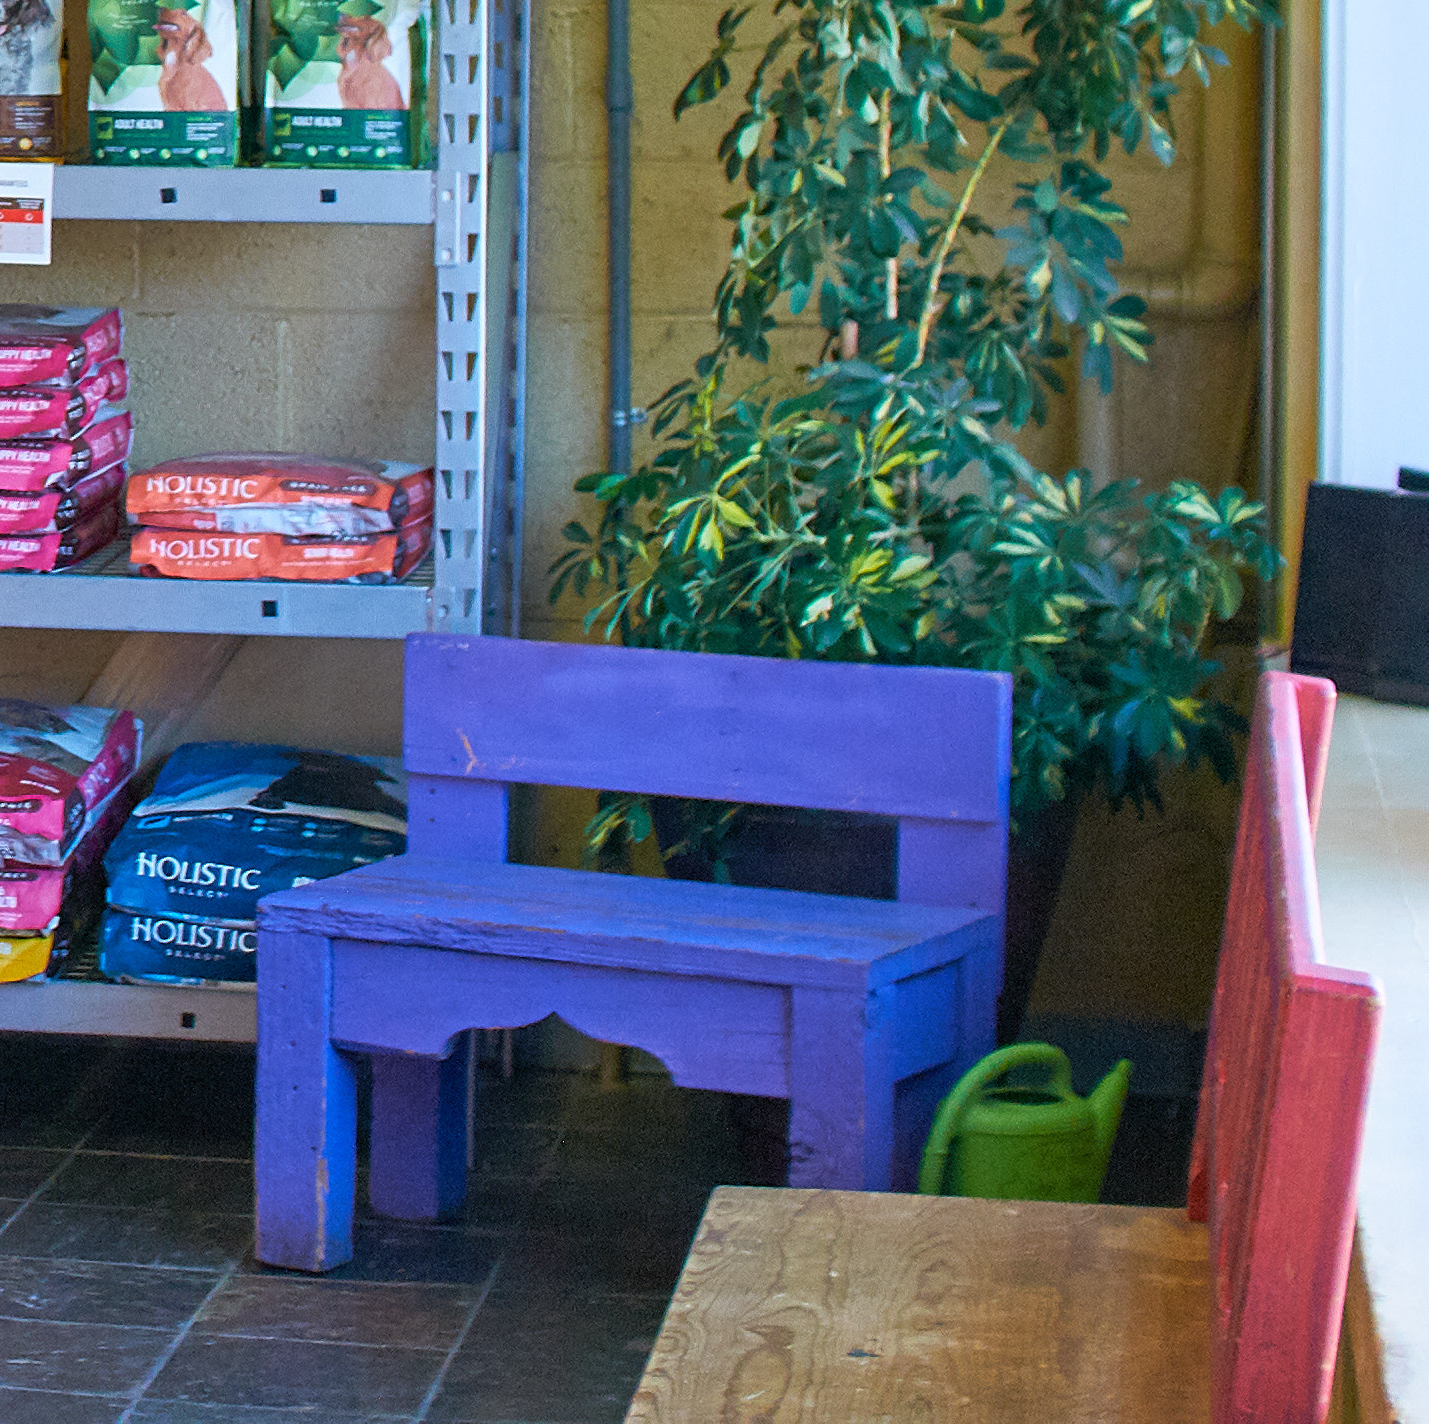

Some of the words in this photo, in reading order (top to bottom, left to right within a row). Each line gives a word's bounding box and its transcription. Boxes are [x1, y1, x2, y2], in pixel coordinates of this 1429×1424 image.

[146, 476, 258, 499] HOLISTIC
[149, 538, 260, 559] HOLISTIC
[136, 852, 261, 890] HOLISTIC
[131, 917, 257, 953] HOLISTIC
